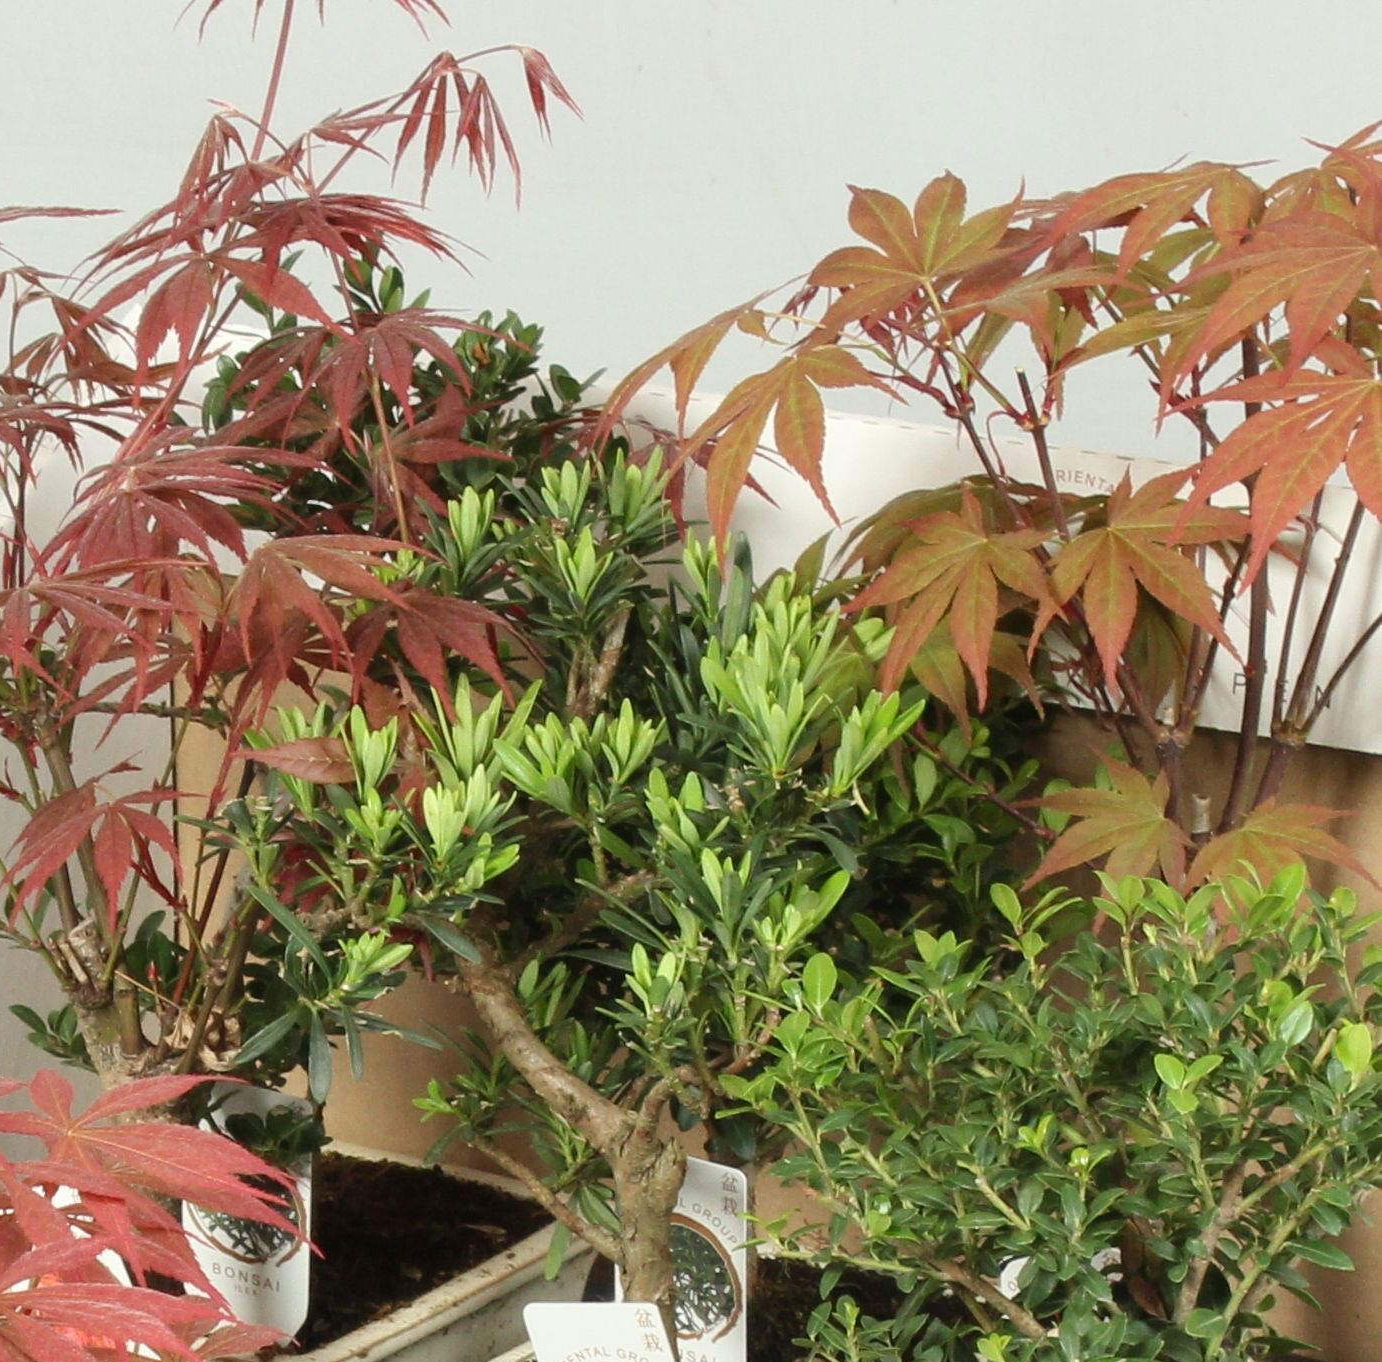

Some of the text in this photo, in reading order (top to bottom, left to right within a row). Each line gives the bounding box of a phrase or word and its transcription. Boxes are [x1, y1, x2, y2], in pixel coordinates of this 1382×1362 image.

[1056, 470, 1114, 494] RIENTA
[692, 1203, 738, 1244] GROUP
[212, 1262, 280, 1292] BONSAI
